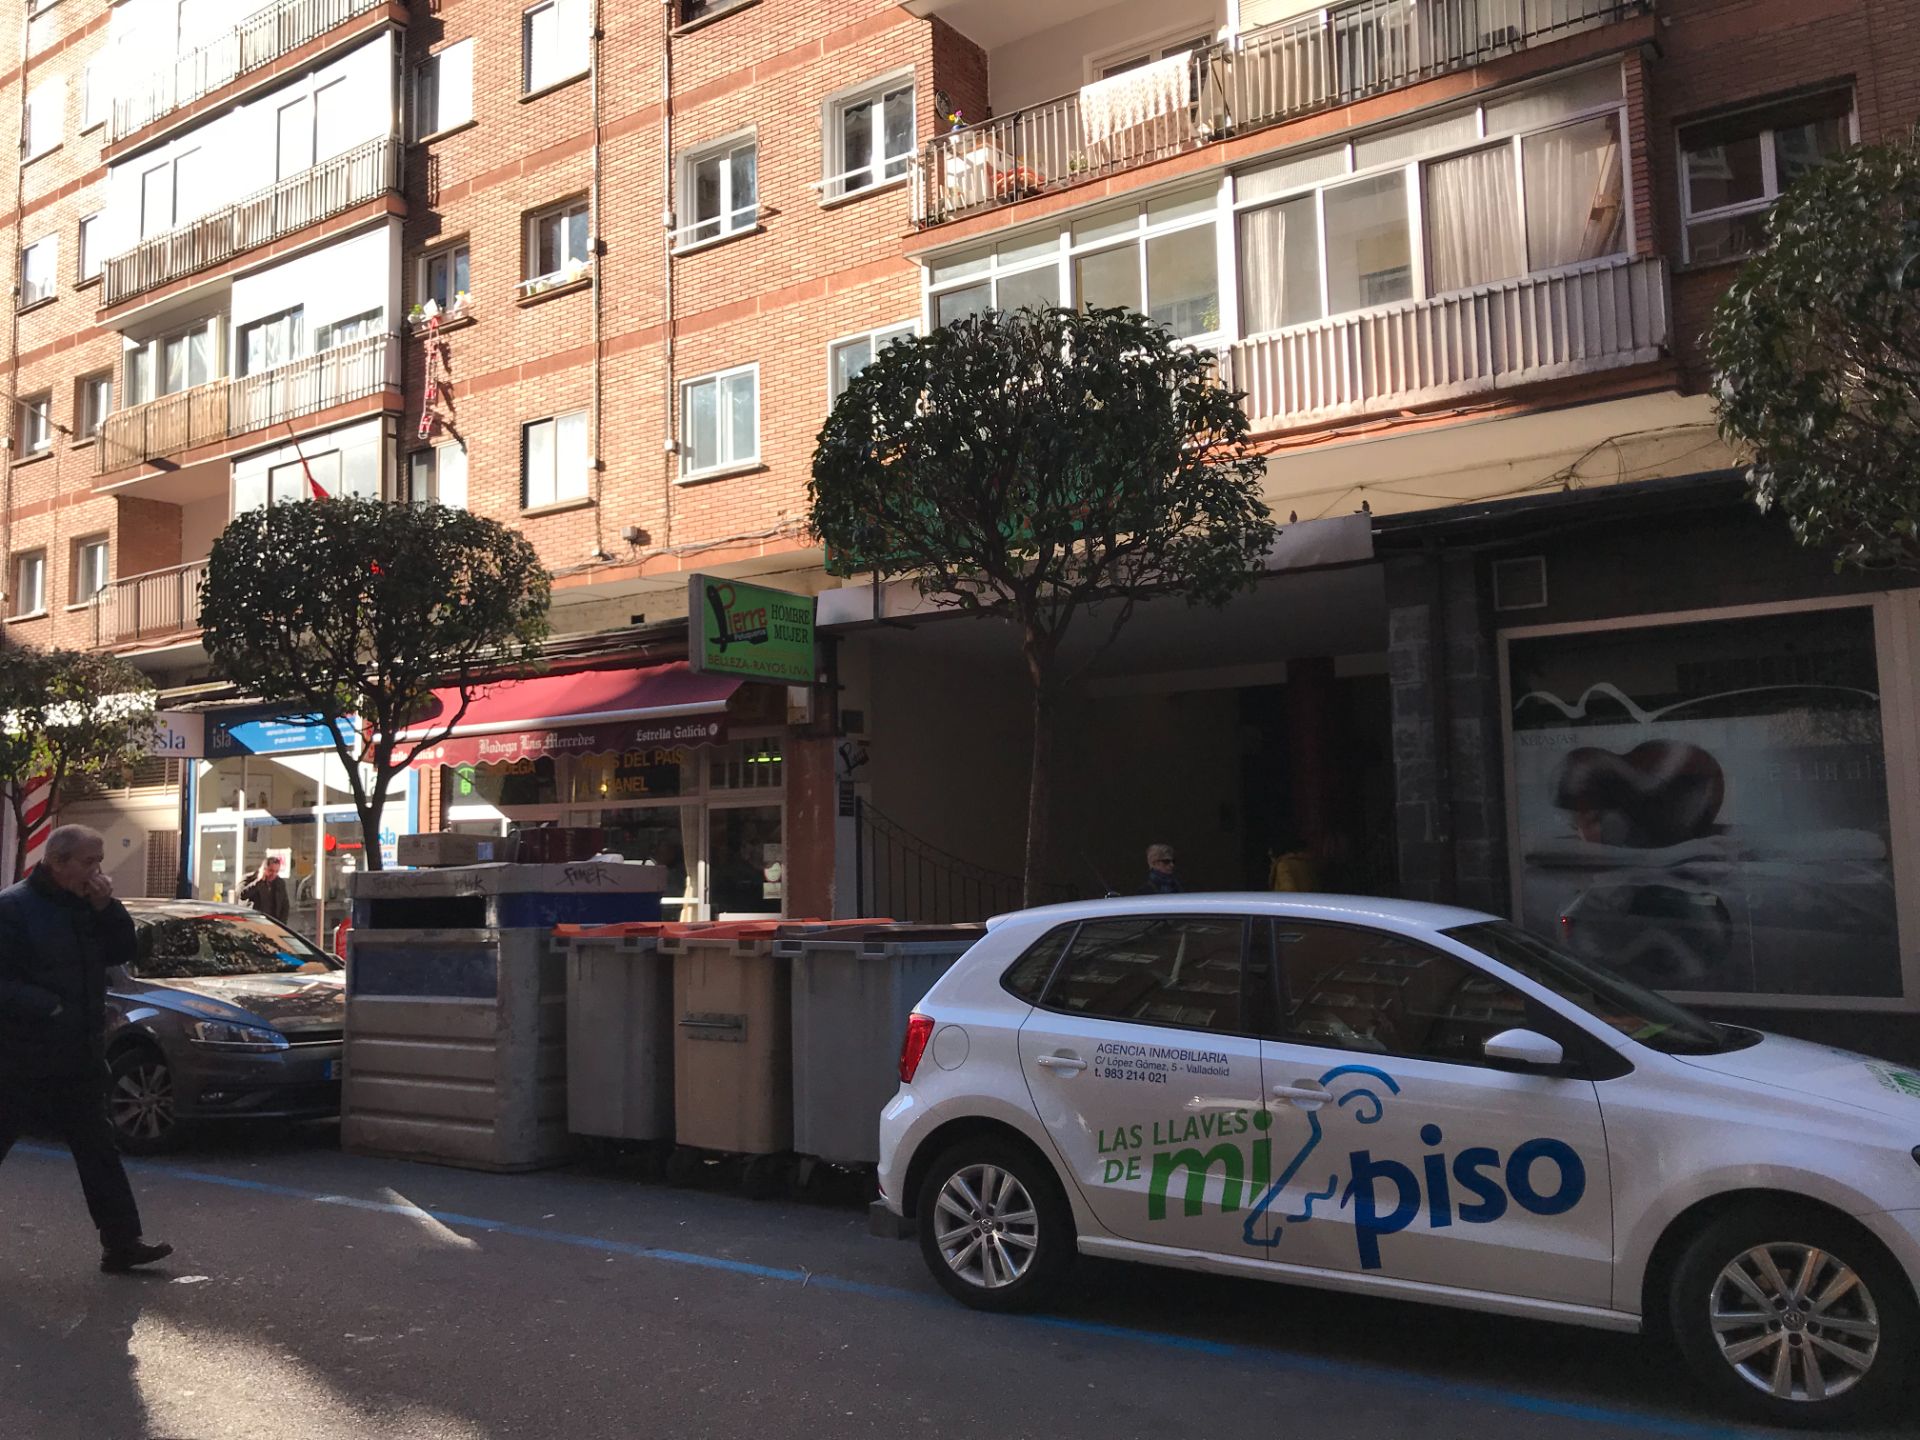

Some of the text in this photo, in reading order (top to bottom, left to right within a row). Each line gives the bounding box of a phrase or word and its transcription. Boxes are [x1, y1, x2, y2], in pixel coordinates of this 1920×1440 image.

[771, 603, 810, 625] HOMBRE
[774, 624, 808, 643] MUJER
[789, 664, 810, 677] UVA
[212, 728, 231, 749] isla
[479, 739, 517, 756] Bodega
[542, 732, 595, 751] Mercedes
[636, 728, 671, 741] Estrella
[673, 724, 707, 738] Galicia
[624, 751, 651, 768] DEL
[377, 826, 396, 847] sla
[1096, 1043, 1229, 1065] AGENCIA INMOBILIARIA
[1095, 1055, 1105, 1065] C/
[1108, 1057, 1133, 1068] López
[1135, 1059, 1169, 1072] Gómez,
[1171, 1062, 1178, 1072] 5
[1186, 1064, 1230, 1077] Valladolid
[1104, 1068, 1124, 1079] 983
[1126, 1070, 1145, 1081] 214
[1148, 1072, 1167, 1083] 021
[1098, 1109, 1249, 1154] LAS LLAVES
[1103, 1110, 1586, 1269] DE mi piso
